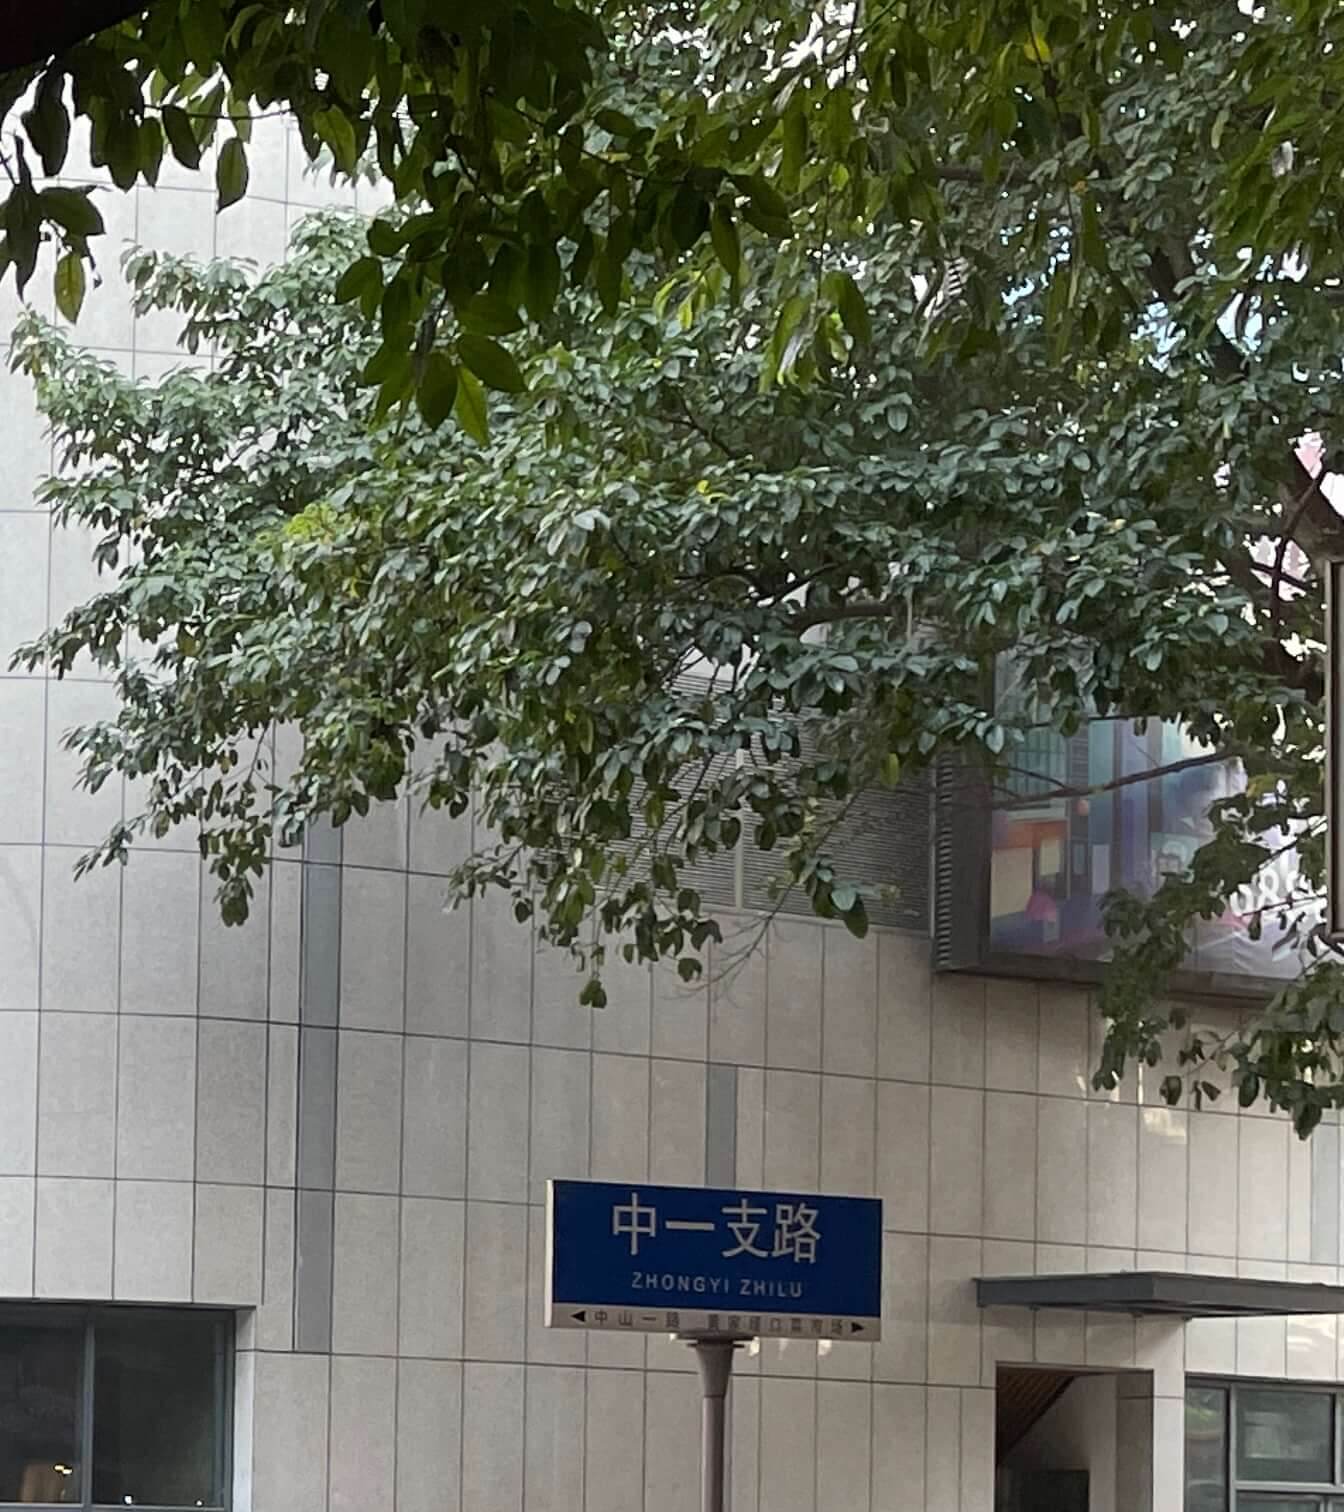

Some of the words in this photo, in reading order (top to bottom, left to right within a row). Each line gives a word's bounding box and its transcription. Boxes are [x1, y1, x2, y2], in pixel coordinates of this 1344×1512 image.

[612, 1192, 821, 1264] 中一支路
[630, 1271, 730, 1294] ZHONGYI
[739, 1278, 803, 1298] ZHILU
